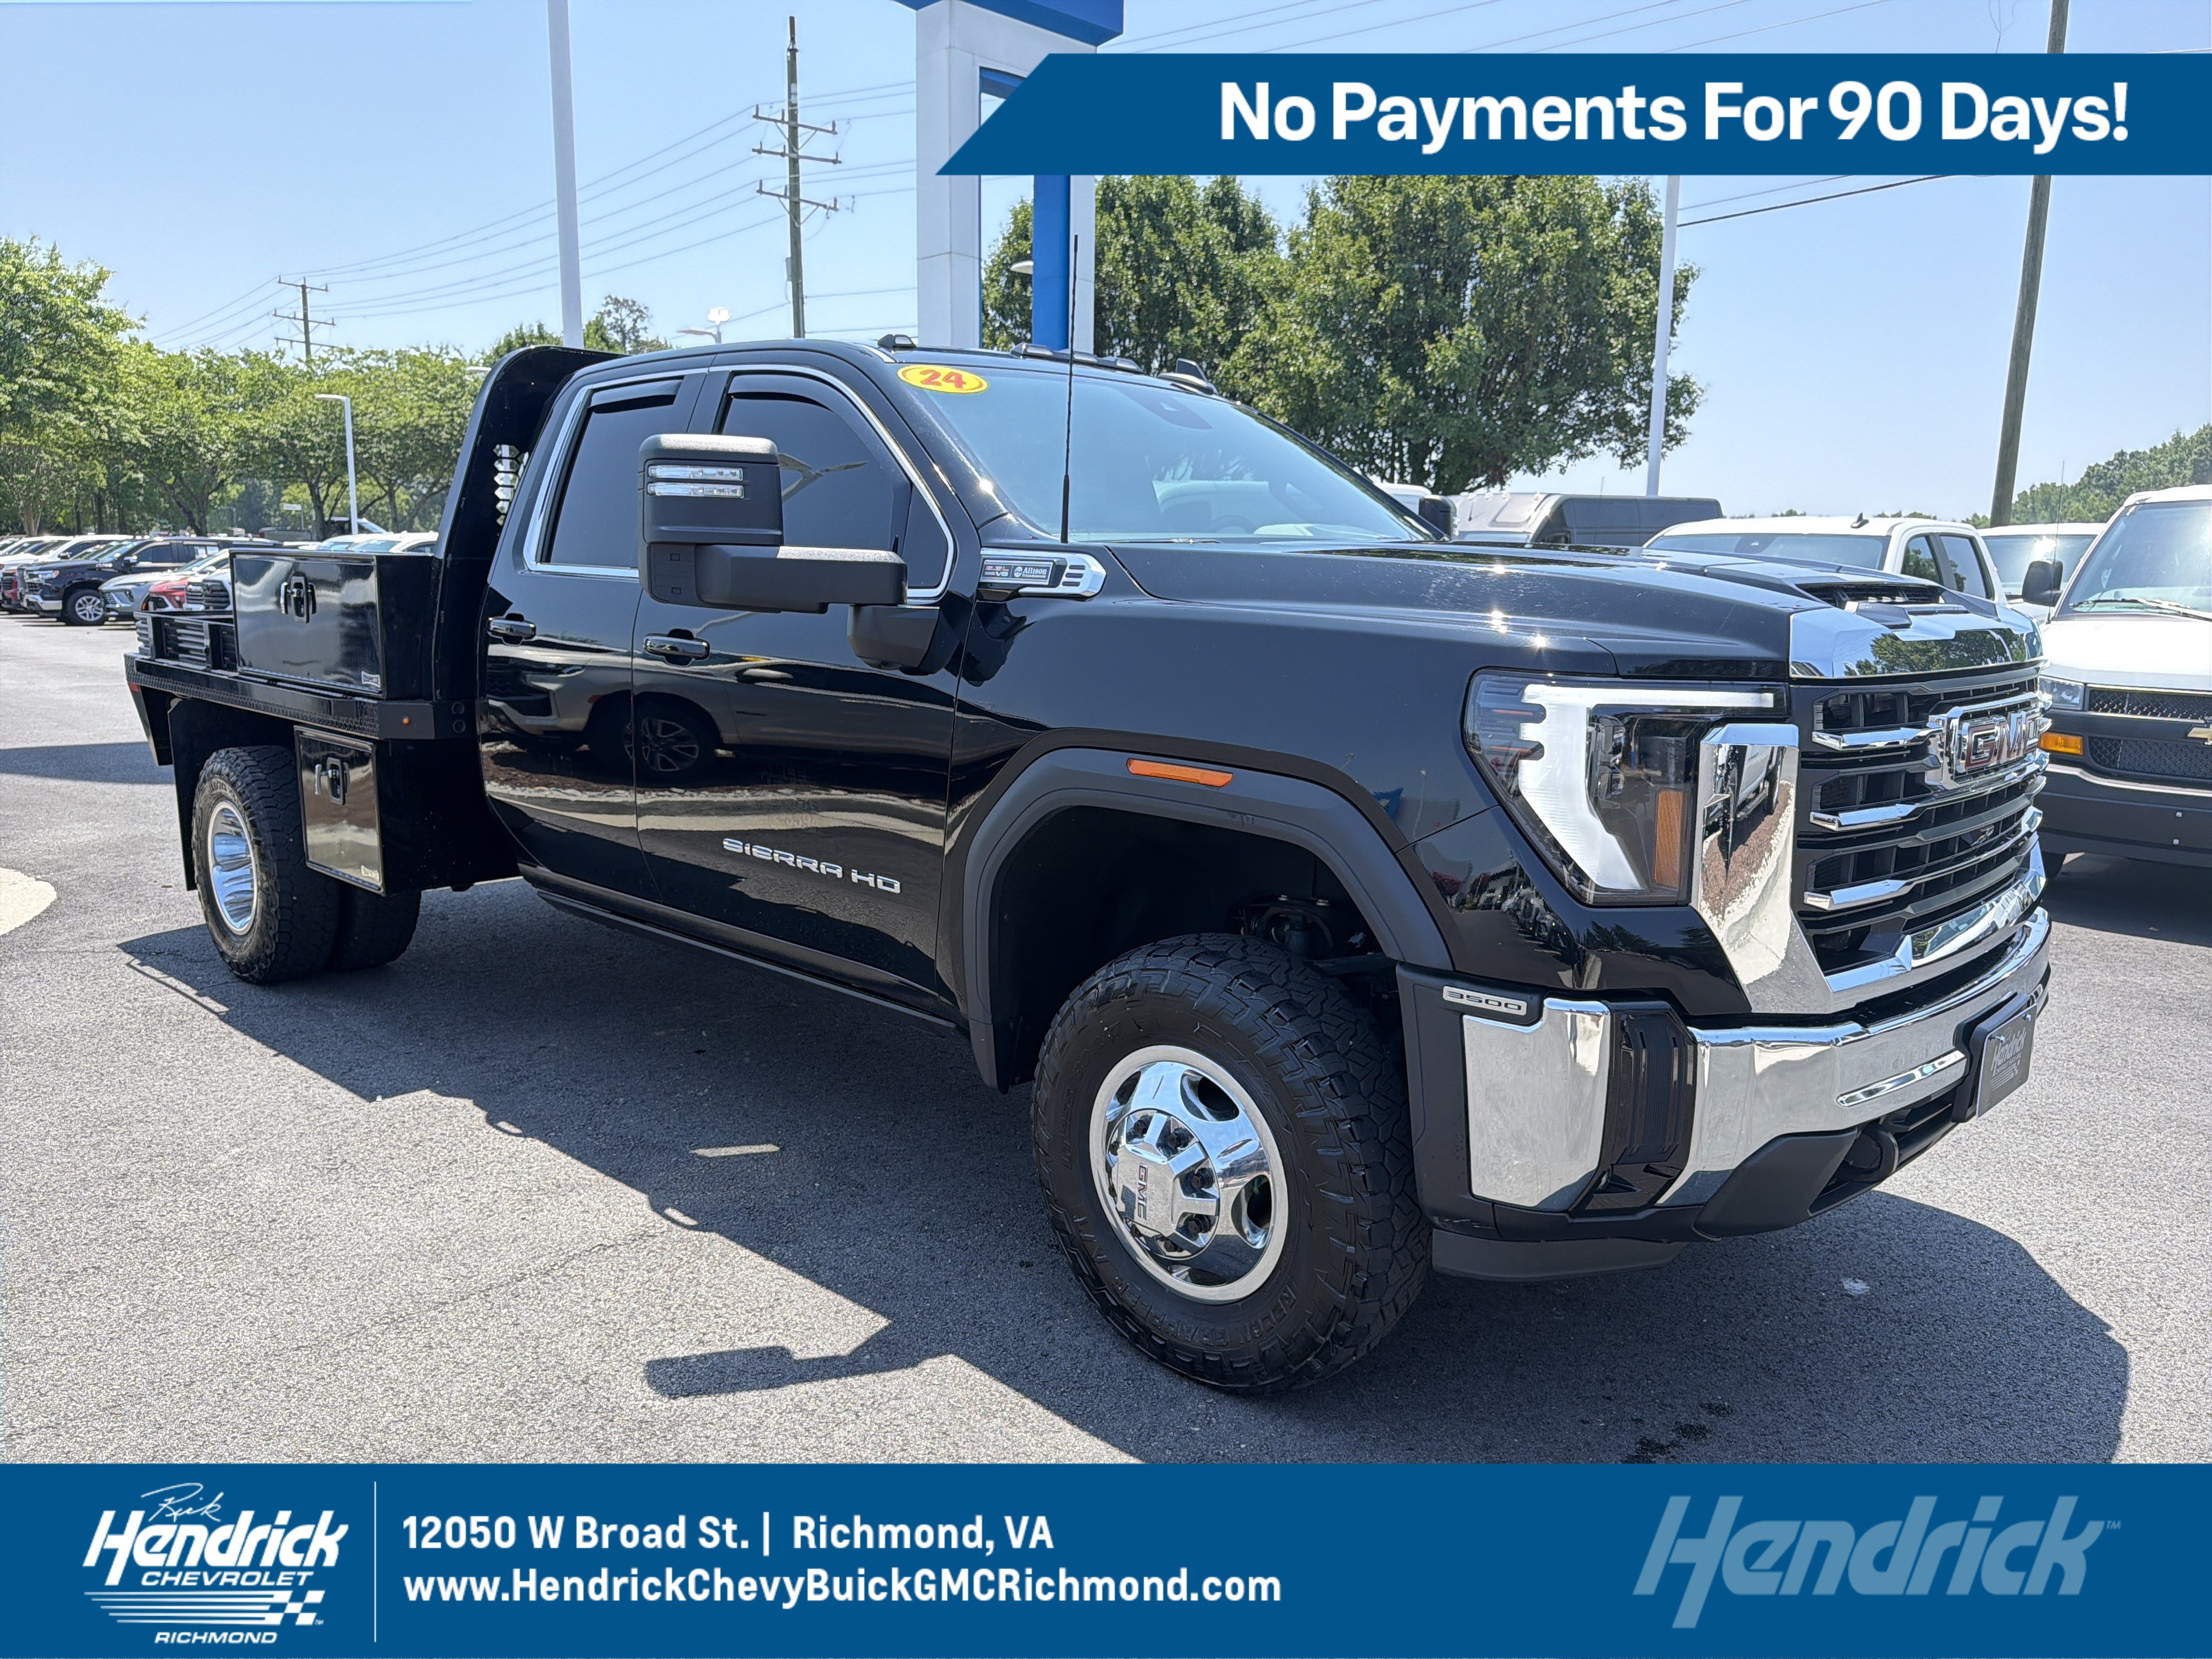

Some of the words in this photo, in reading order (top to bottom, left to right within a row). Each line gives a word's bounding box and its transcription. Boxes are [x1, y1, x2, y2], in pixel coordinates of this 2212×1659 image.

[919, 369, 967, 390] 24
[1023, 566, 1047, 575] Allison
[1965, 710, 2039, 770] GMC
[723, 838, 843, 878] SIERRA
[851, 869, 901, 894] HD
[1447, 991, 1522, 1011] 3500
[1990, 1026, 2027, 1077] Hendrick
[1137, 1163, 1148, 1220] GMC
